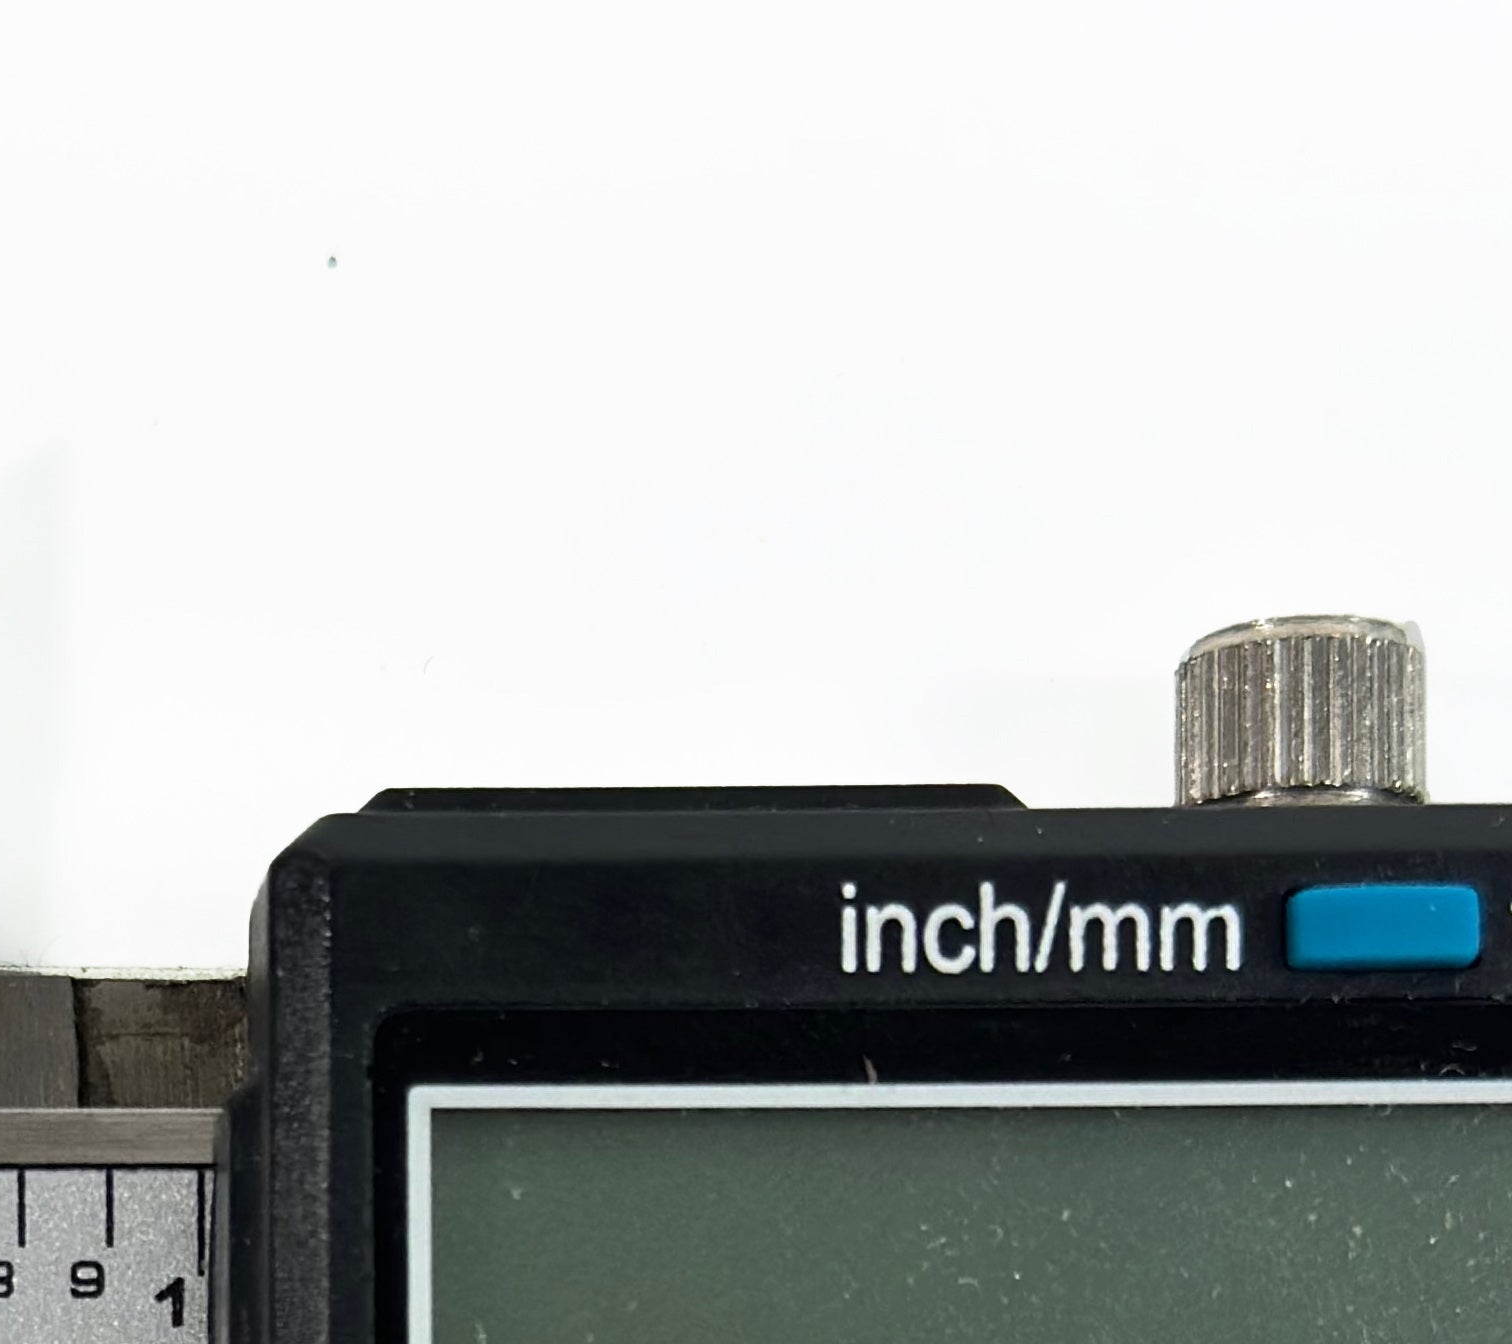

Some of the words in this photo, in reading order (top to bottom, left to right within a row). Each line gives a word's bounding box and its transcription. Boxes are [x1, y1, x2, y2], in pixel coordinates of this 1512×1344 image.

[841, 880, 1242, 975] inch/mm
[68, 1259, 107, 1300] 9
[153, 1275, 187, 1330] 1
